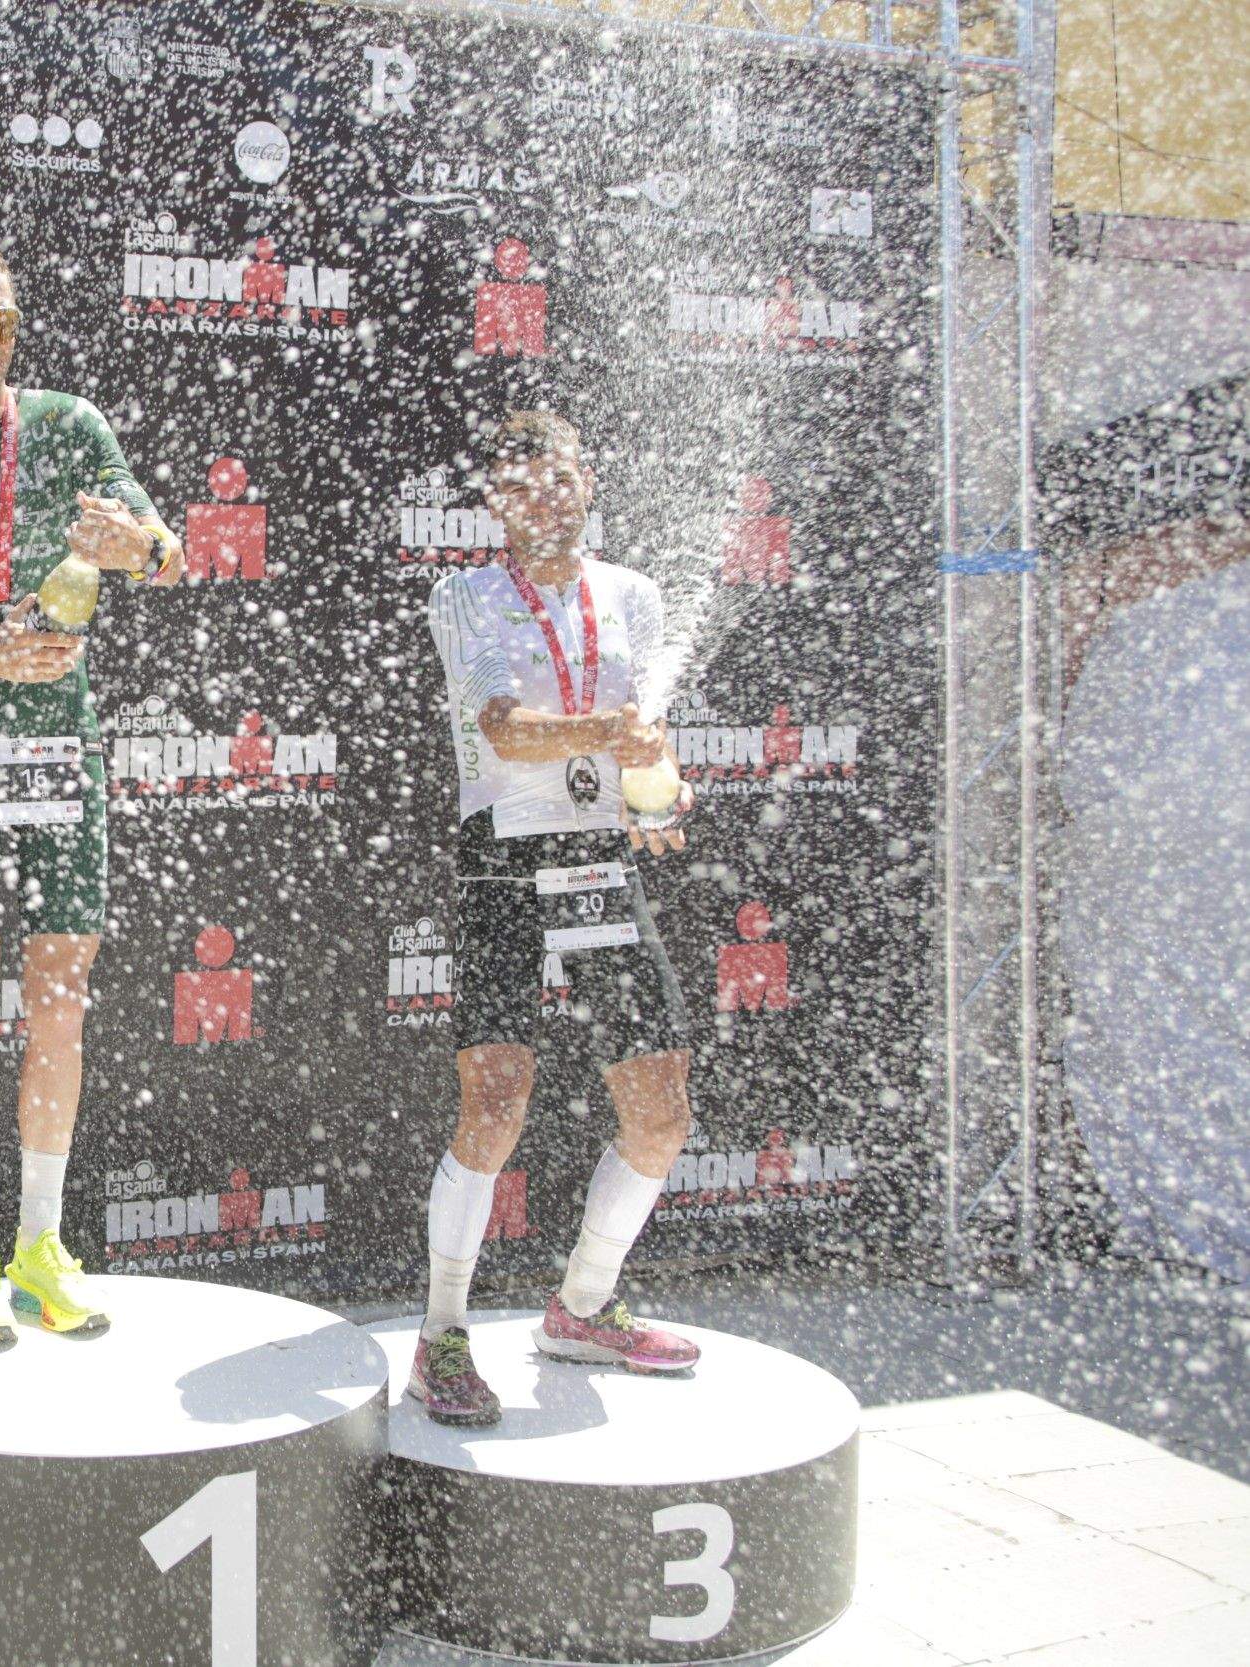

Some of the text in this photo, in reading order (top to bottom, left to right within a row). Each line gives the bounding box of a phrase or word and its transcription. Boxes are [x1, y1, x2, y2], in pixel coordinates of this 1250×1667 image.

[12, 149, 101, 172] Securitas
[405, 158, 531, 193] ARMAS
[124, 254, 350, 309] IRONMAN
[123, 316, 349, 342] CANARIAS SPAIN
[406, 473, 427, 487] Club
[120, 702, 143, 717] Club
[114, 713, 177, 735] LaSanta
[114, 734, 337, 778] IRONMAN
[792, 780, 857, 793] SPAIN
[260, 792, 335, 807] SPAIN
[576, 893, 604, 914] 20
[394, 925, 415, 939] Club
[389, 935, 445, 955] LaSanta
[112, 1169, 135, 1181] Club
[105, 1177, 167, 1199] LaSanta
[106, 1184, 325, 1242] IRONMAN
[108, 1241, 326, 1275] CANARIAS SPAIN
[139, 1470, 257, 1667] 1
[649, 1503, 735, 1643] 3
